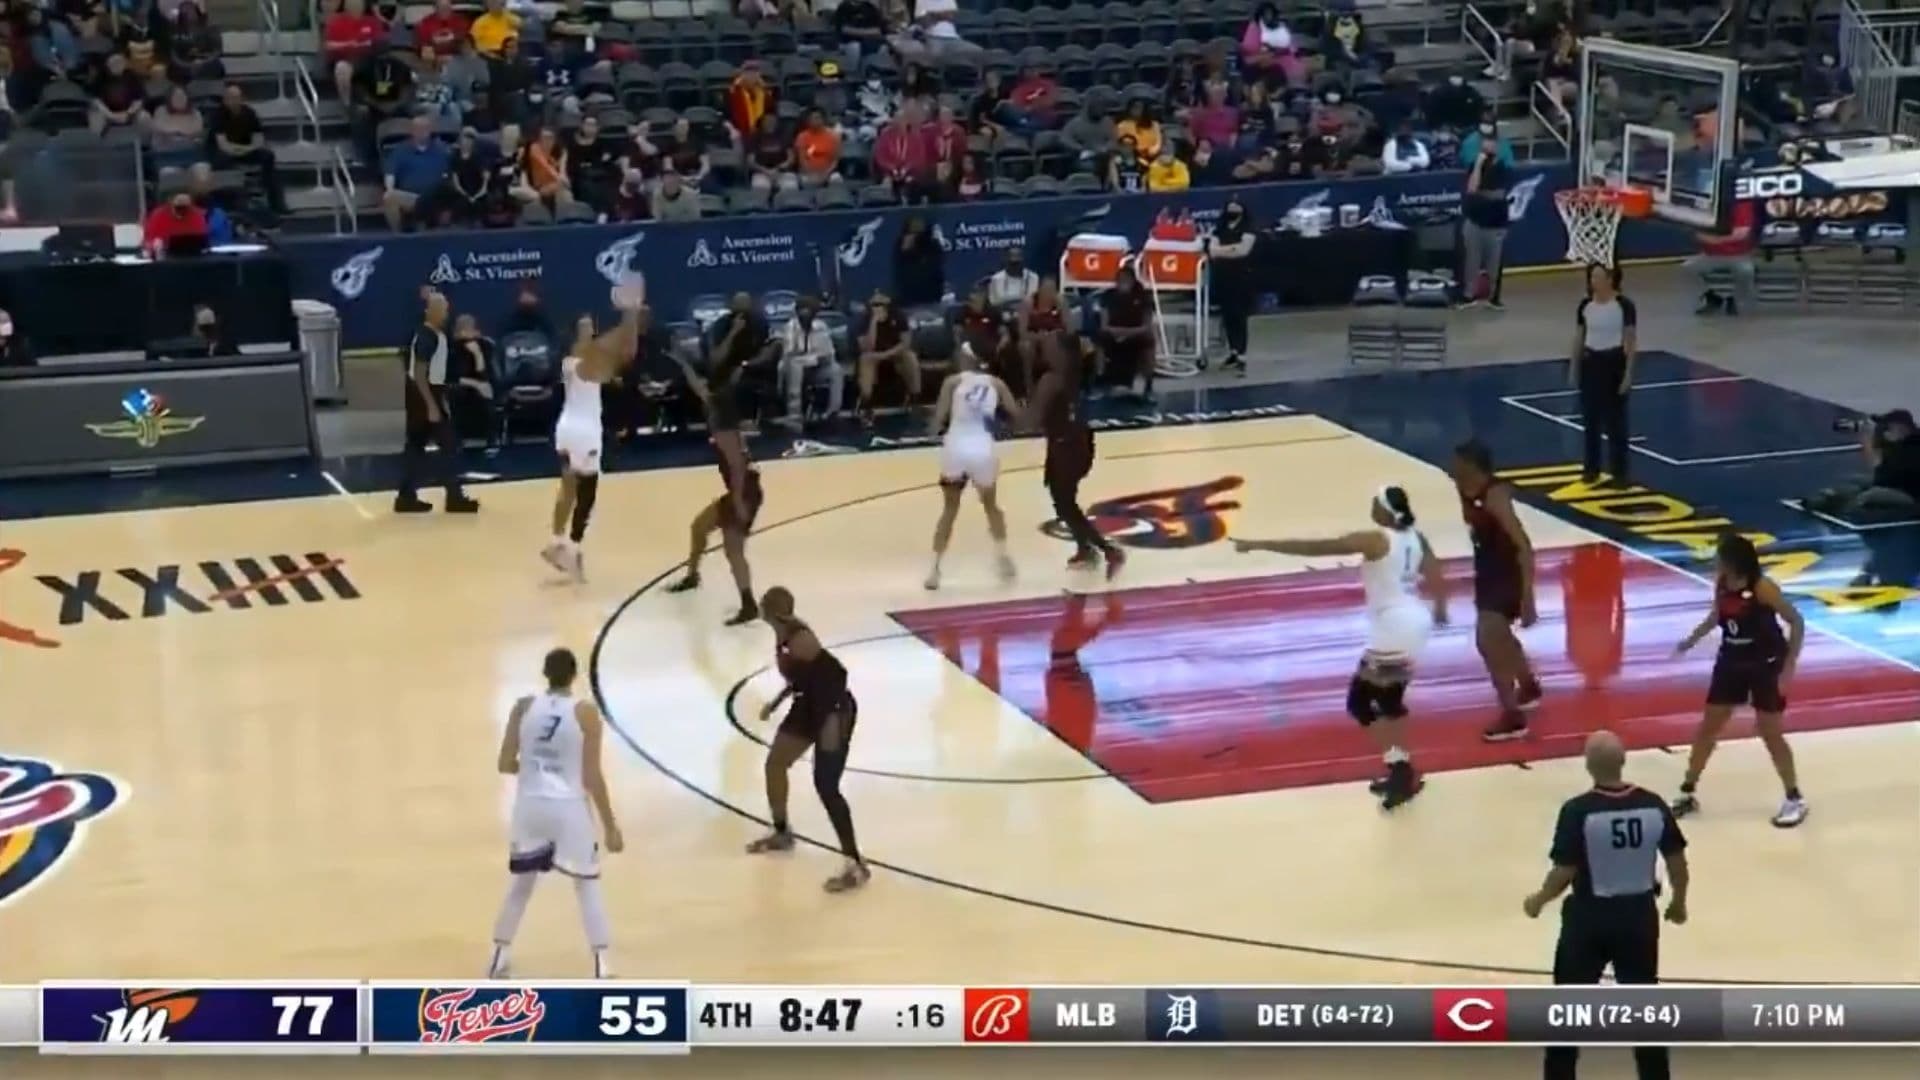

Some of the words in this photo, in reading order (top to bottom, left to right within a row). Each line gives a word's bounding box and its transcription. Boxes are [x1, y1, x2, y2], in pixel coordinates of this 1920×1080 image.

[957, 220, 1025, 235] Ascension
[722, 234, 793, 249] Ascension
[974, 235, 1027, 250] Vincent
[465, 248, 541, 264] Ascension
[721, 252, 740, 265] St.
[740, 249, 795, 264] Vincent
[1085, 253, 1100, 271] G
[1161, 254, 1179, 273] G
[464, 266, 485, 280] St.
[485, 265, 543, 280] Vincent
[536, 715, 562, 742] 3
[1611, 817, 1643, 849] 50
